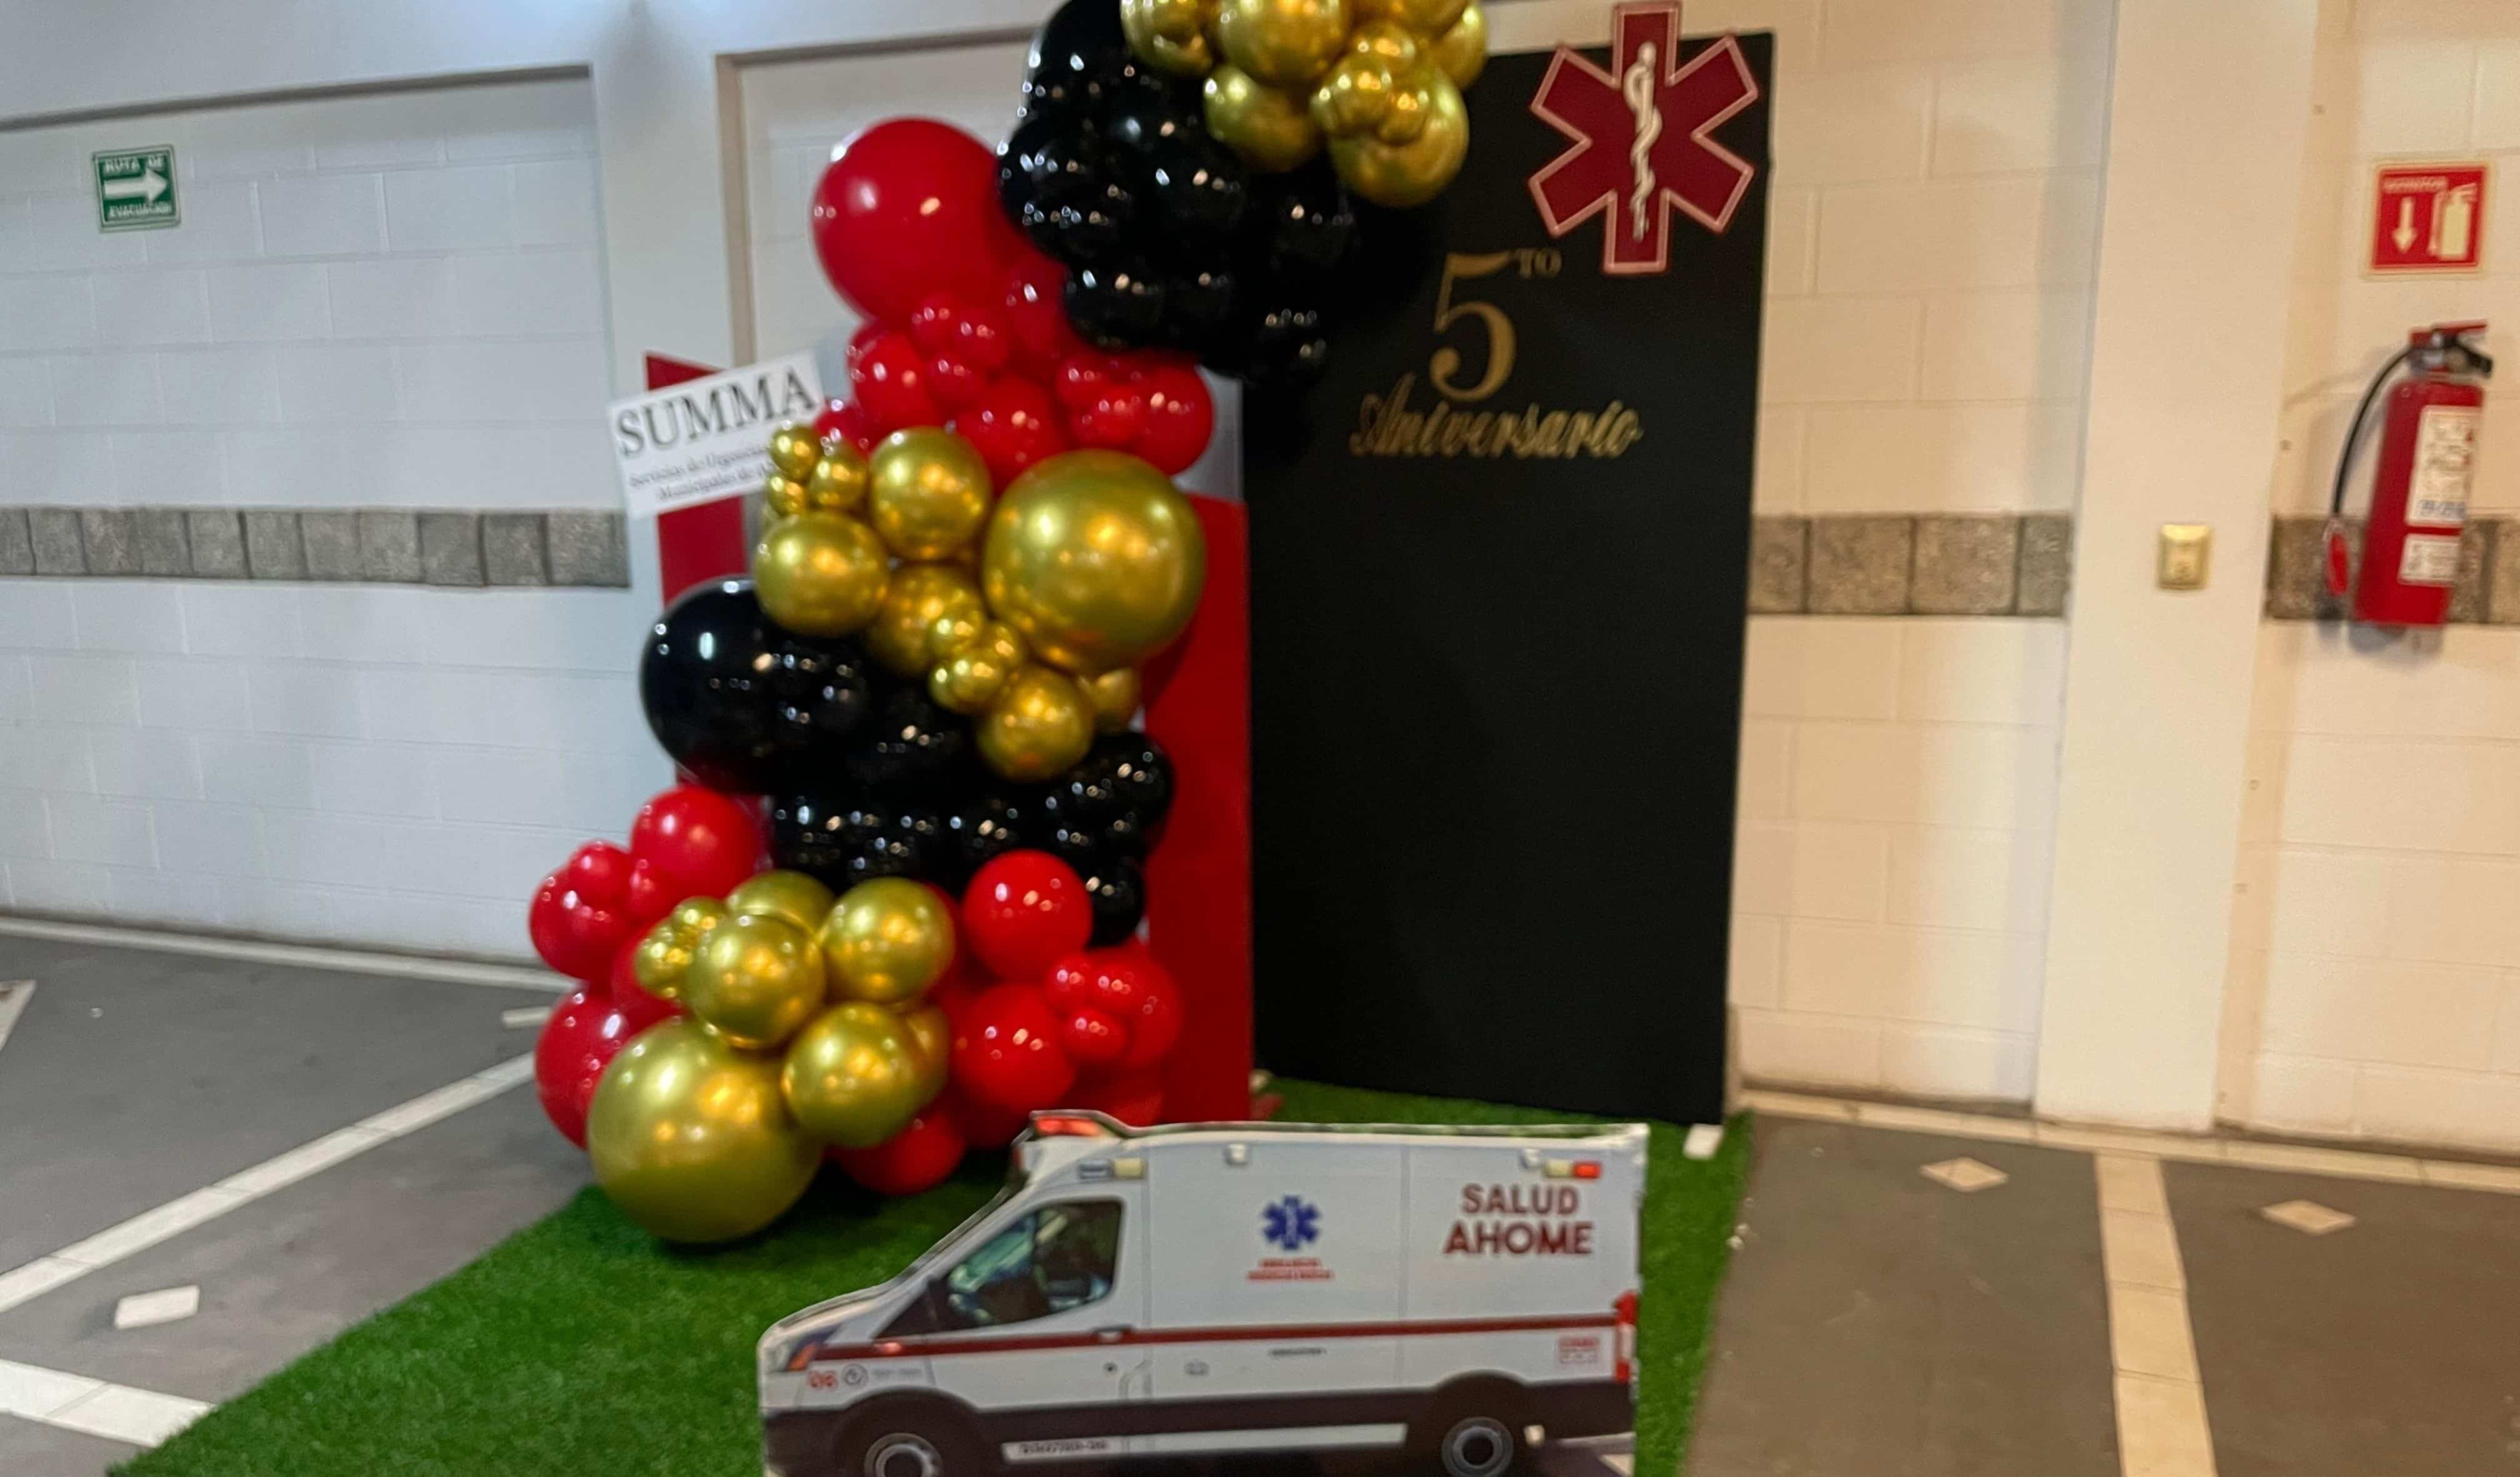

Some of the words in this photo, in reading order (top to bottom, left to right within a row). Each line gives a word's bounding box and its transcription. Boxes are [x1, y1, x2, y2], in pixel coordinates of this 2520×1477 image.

[104, 156, 141, 173] RUTA
[618, 365, 819, 457] SUMMA
[1348, 371, 1645, 459] Aniversario
[1461, 1181, 1580, 1214] SALUD
[1442, 1220, 1594, 1254] AHOME
